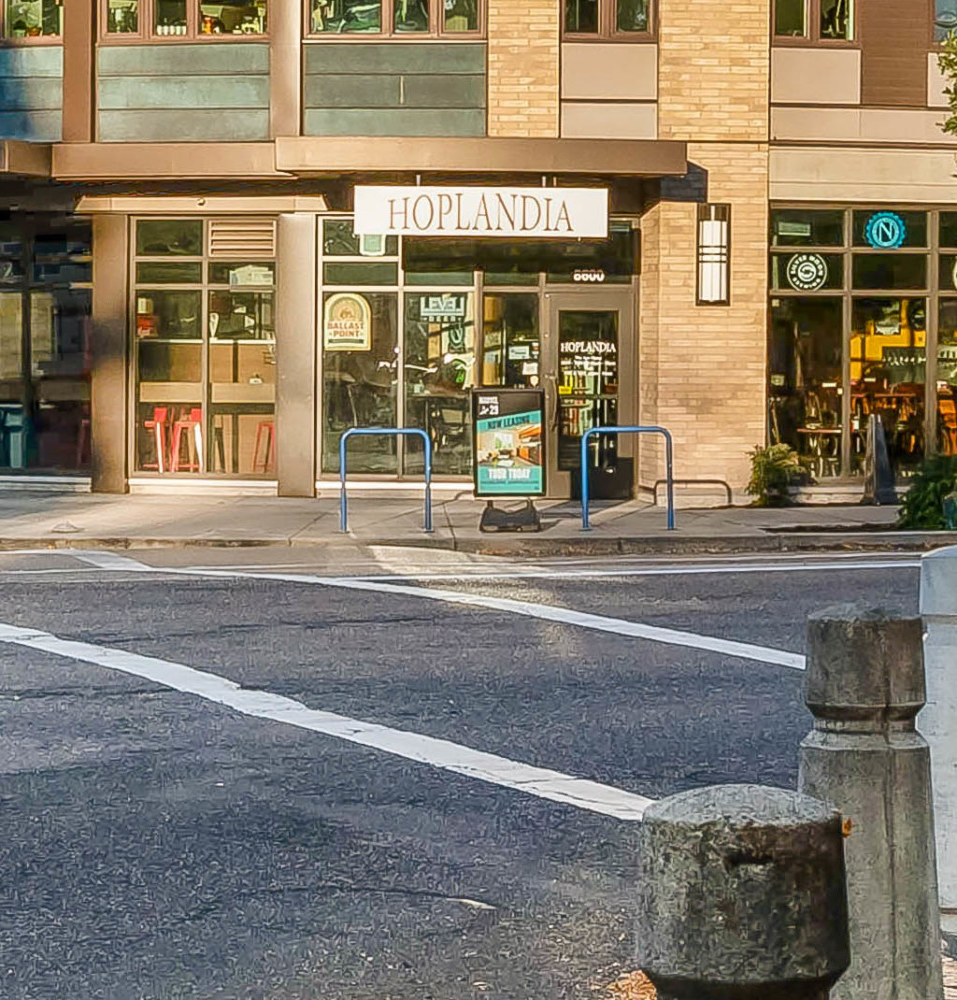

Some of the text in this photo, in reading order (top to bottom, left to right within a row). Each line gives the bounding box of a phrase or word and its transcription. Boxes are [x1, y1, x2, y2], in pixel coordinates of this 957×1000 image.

[388, 192, 574, 232] HOPLANDIA
[333, 330, 360, 338] POINT
[560, 341, 617, 354] HOPLANDIA
